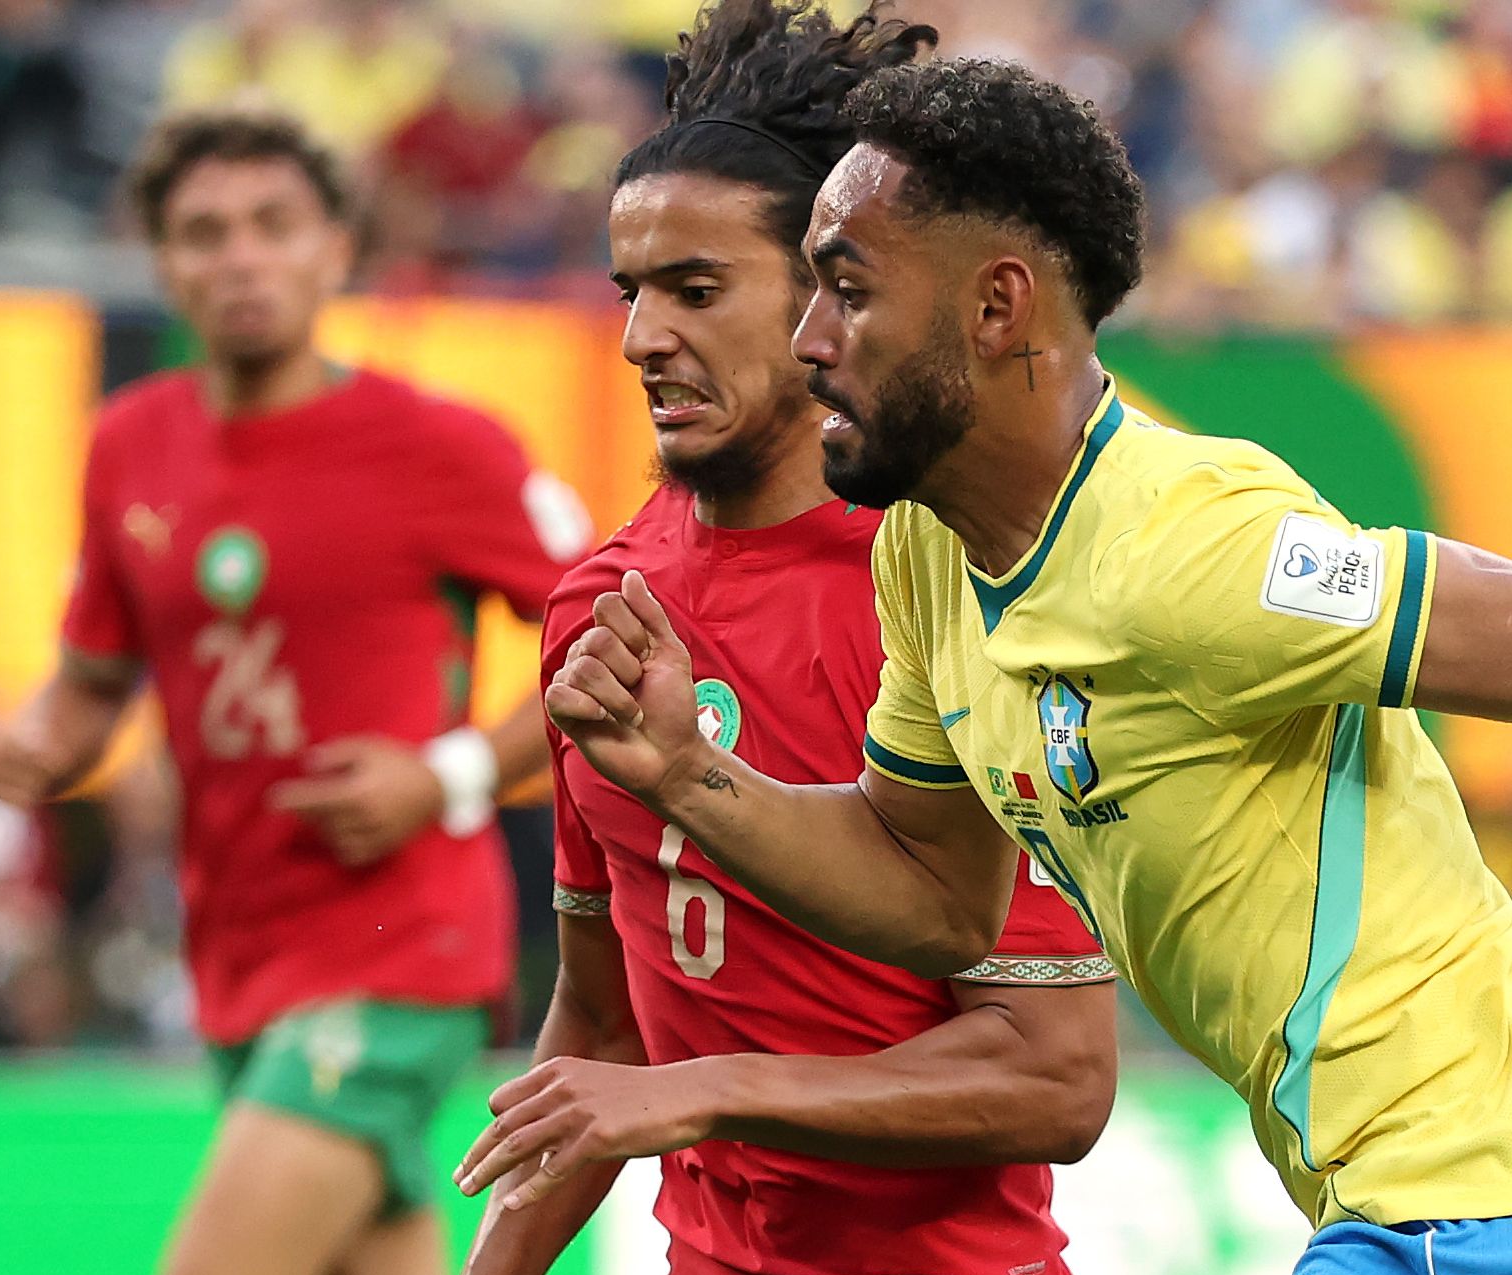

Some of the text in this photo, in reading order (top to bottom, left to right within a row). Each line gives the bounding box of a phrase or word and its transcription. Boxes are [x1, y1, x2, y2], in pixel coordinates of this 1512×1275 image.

[1338, 550, 1361, 595] PEACE
[1360, 565, 1369, 589] FIFA
[193, 614, 306, 762] 24
[1051, 729, 1070, 744] CBF
[657, 822, 726, 981] 6
